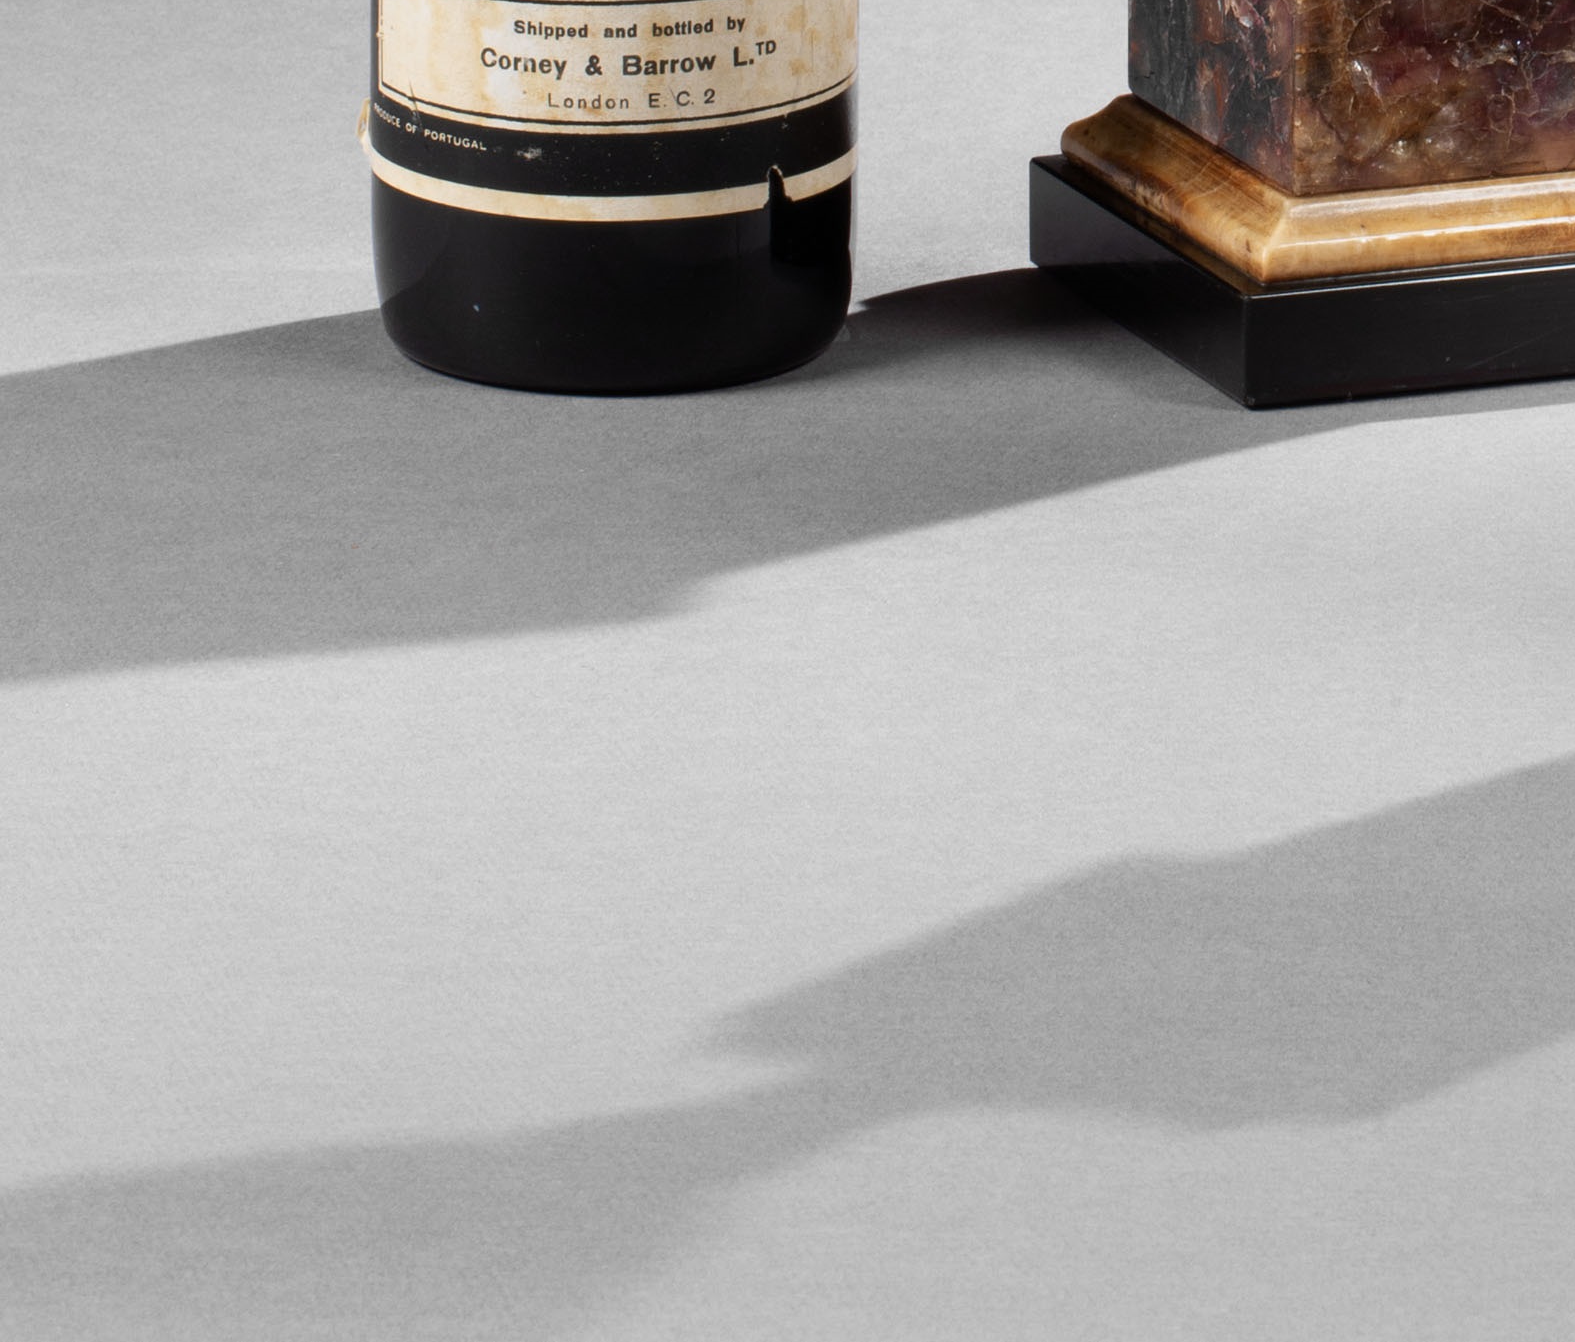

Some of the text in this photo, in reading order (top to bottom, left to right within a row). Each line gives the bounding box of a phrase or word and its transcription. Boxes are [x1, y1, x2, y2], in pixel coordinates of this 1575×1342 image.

[513, 16, 746, 40] Shipped and bottled by
[480, 47, 568, 81] Corney
[584, 54, 603, 76] &
[621, 53, 717, 77] Barrow
[546, 92, 631, 111] London
[405, 122, 418, 134] OF
[423, 128, 488, 152] PORTUGAL
